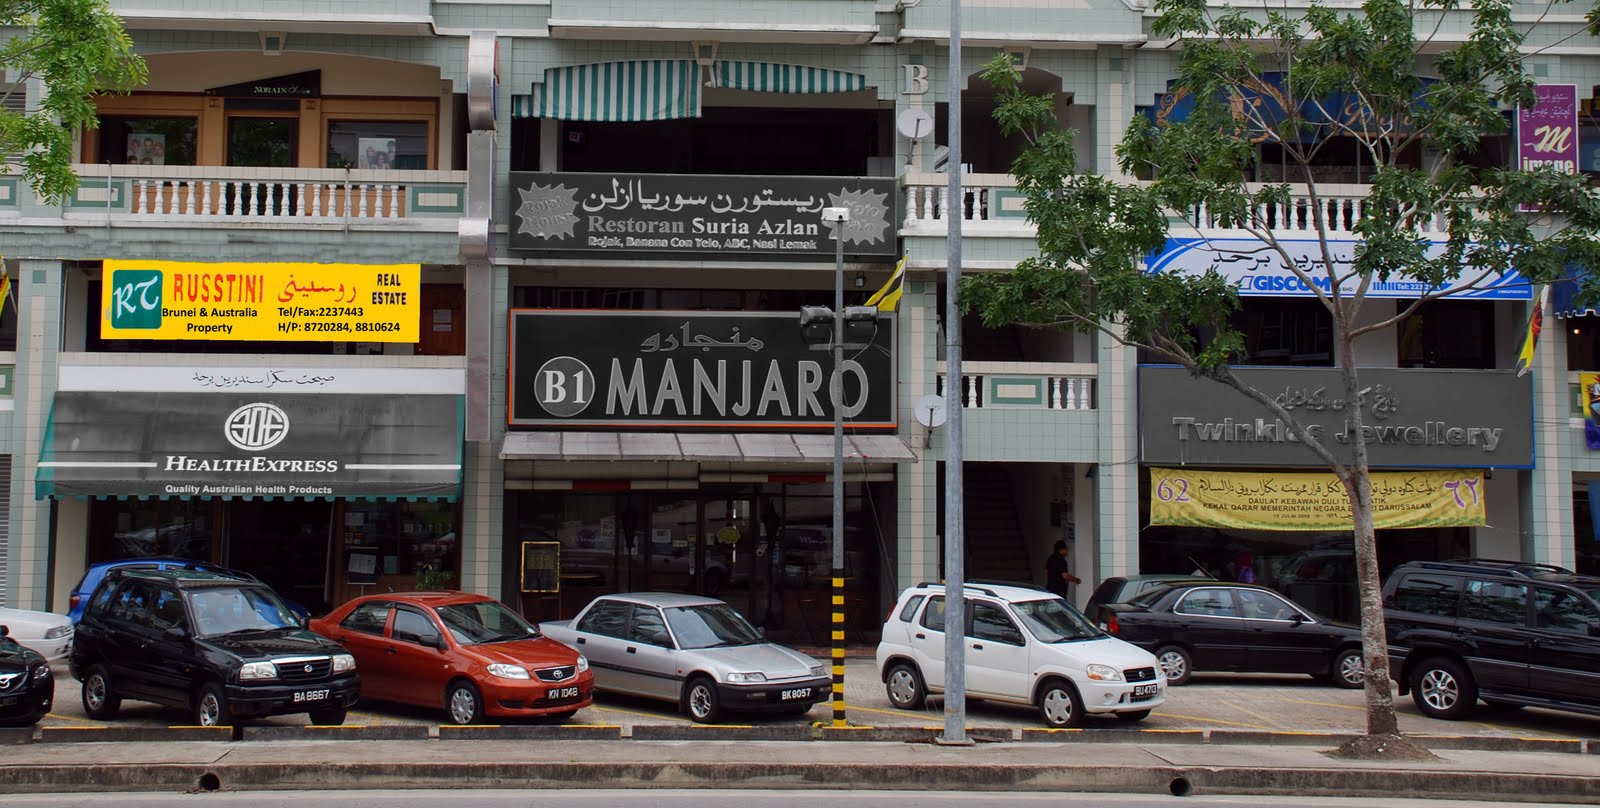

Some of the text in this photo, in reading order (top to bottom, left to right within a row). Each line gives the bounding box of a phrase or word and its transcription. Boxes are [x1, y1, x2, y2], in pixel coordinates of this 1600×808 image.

[901, 64, 929, 95] B
[587, 214, 819, 236] Restoran Suria Azlan
[588, 235, 624, 248] Rojak,
[626, 236, 669, 248] Banana
[670, 237, 693, 248] Con
[752, 238, 778, 249] Nasi
[779, 238, 818, 250] Lemak
[377, 273, 401, 287] REAL
[1252, 275, 1333, 292] GISCOM
[173, 273, 264, 303] RUSSTINI
[371, 291, 407, 306] ESTATE
[162, 307, 258, 317] Brunei & Australia
[277, 306, 364, 318] Tel/Fax:2237443
[187, 323, 233, 334] Property
[278, 321, 401, 333] H/P: 8720284, 8810624
[542, 369, 587, 405] B1
[605, 357, 869, 418] MANJARO
[165, 484, 333, 495] Quality Australian Health Products
[1156, 477, 1191, 502] 62
[1202, 502, 1229, 511] KEKAL
[1231, 504, 1259, 512] QARAR
[1379, 502, 1432, 512] DARUSSALAM
[1248, 497, 1279, 505] DAULAT
[1281, 497, 1320, 505] KEBAWAH
[548, 687, 578, 700] KN 1048
